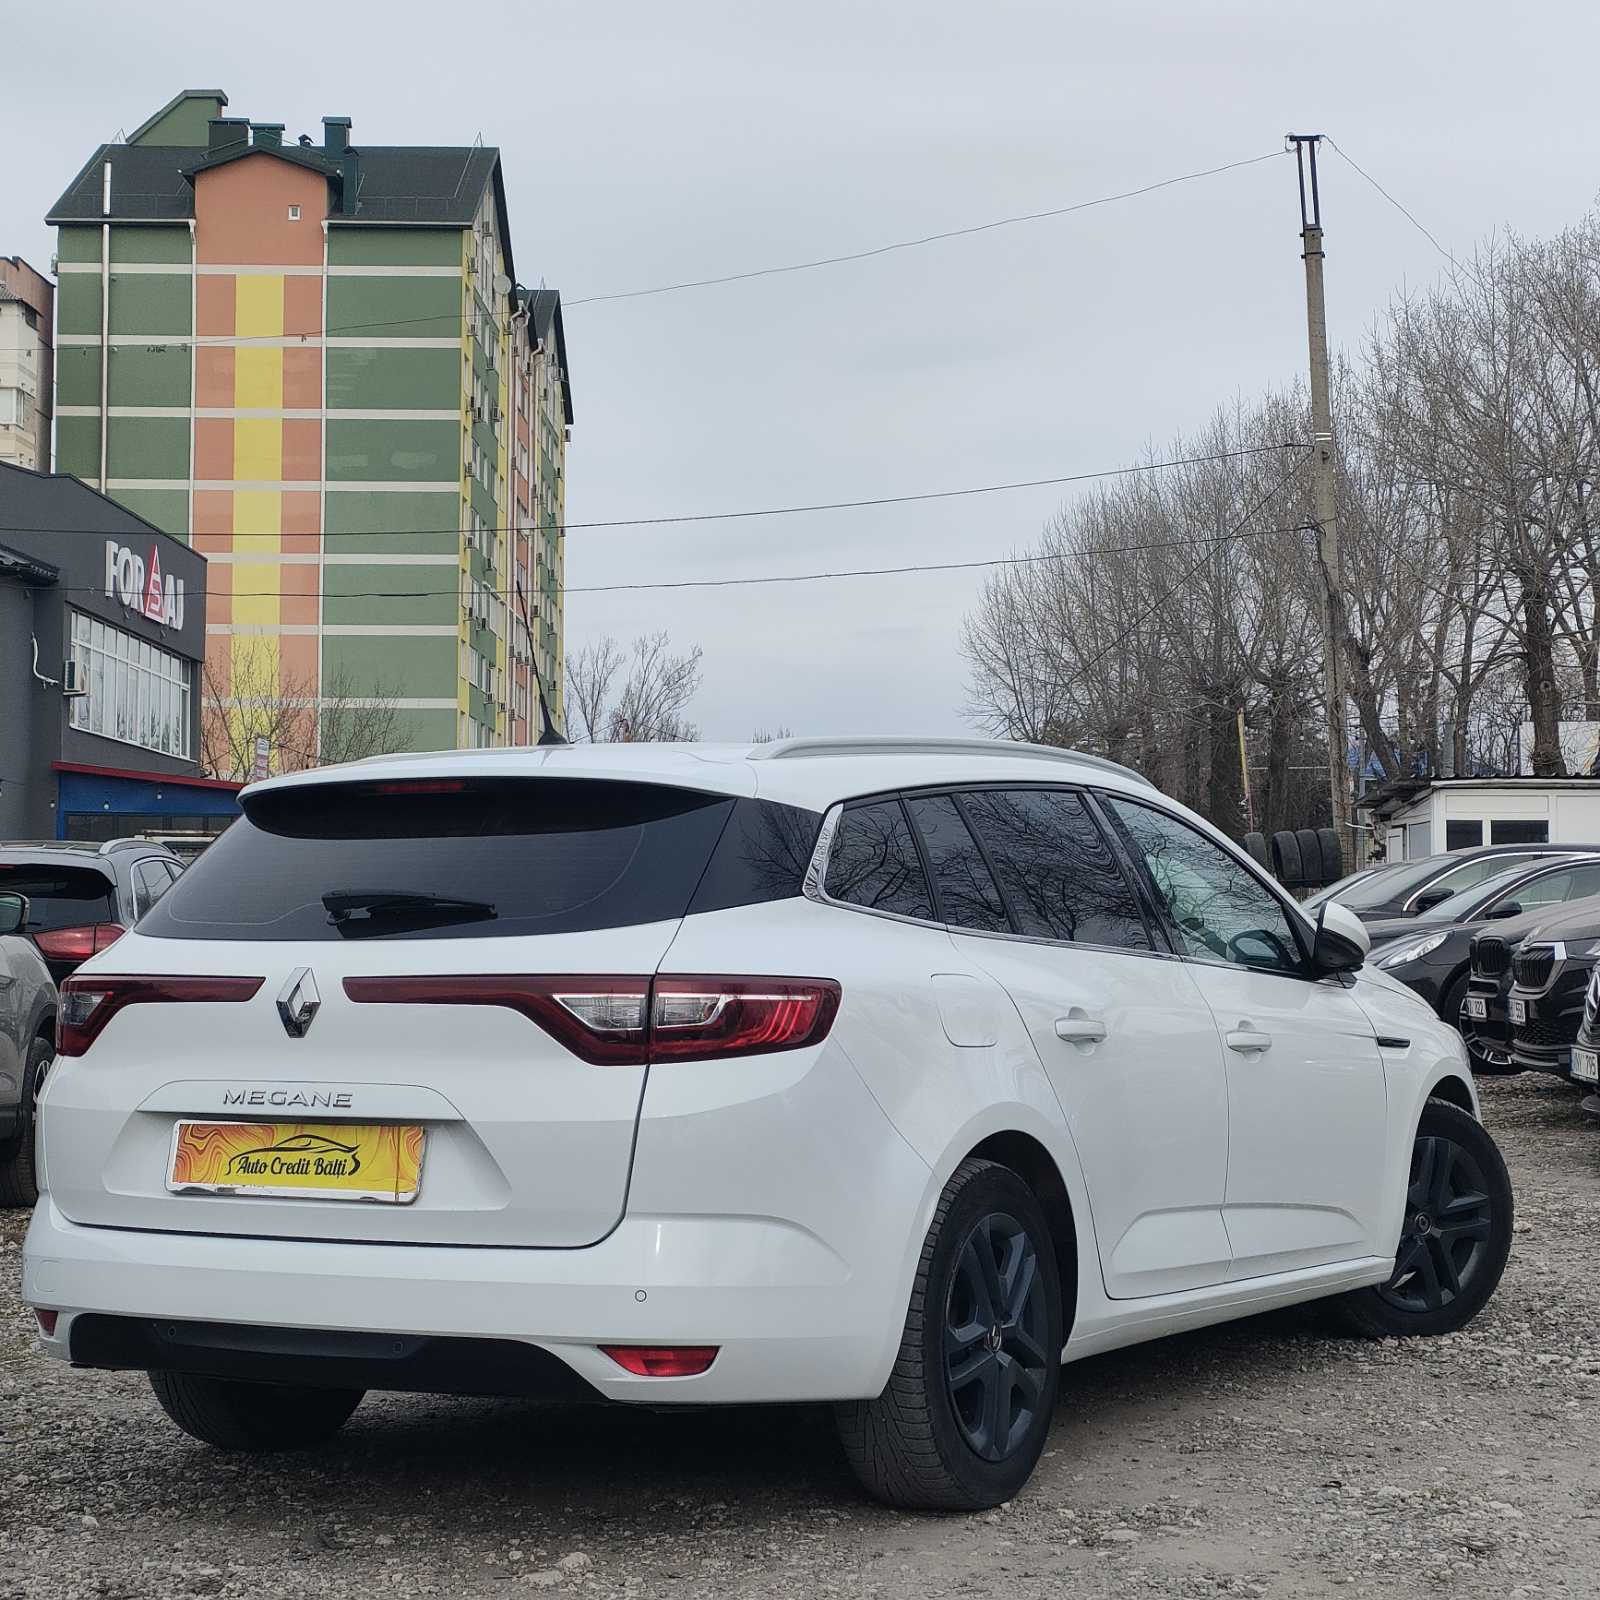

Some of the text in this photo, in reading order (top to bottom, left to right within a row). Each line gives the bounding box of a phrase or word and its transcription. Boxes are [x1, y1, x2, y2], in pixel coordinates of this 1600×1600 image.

[223, 1089, 353, 1108] MEGANE
[236, 1156, 267, 1175] Auto
[270, 1157, 310, 1175] Credit
